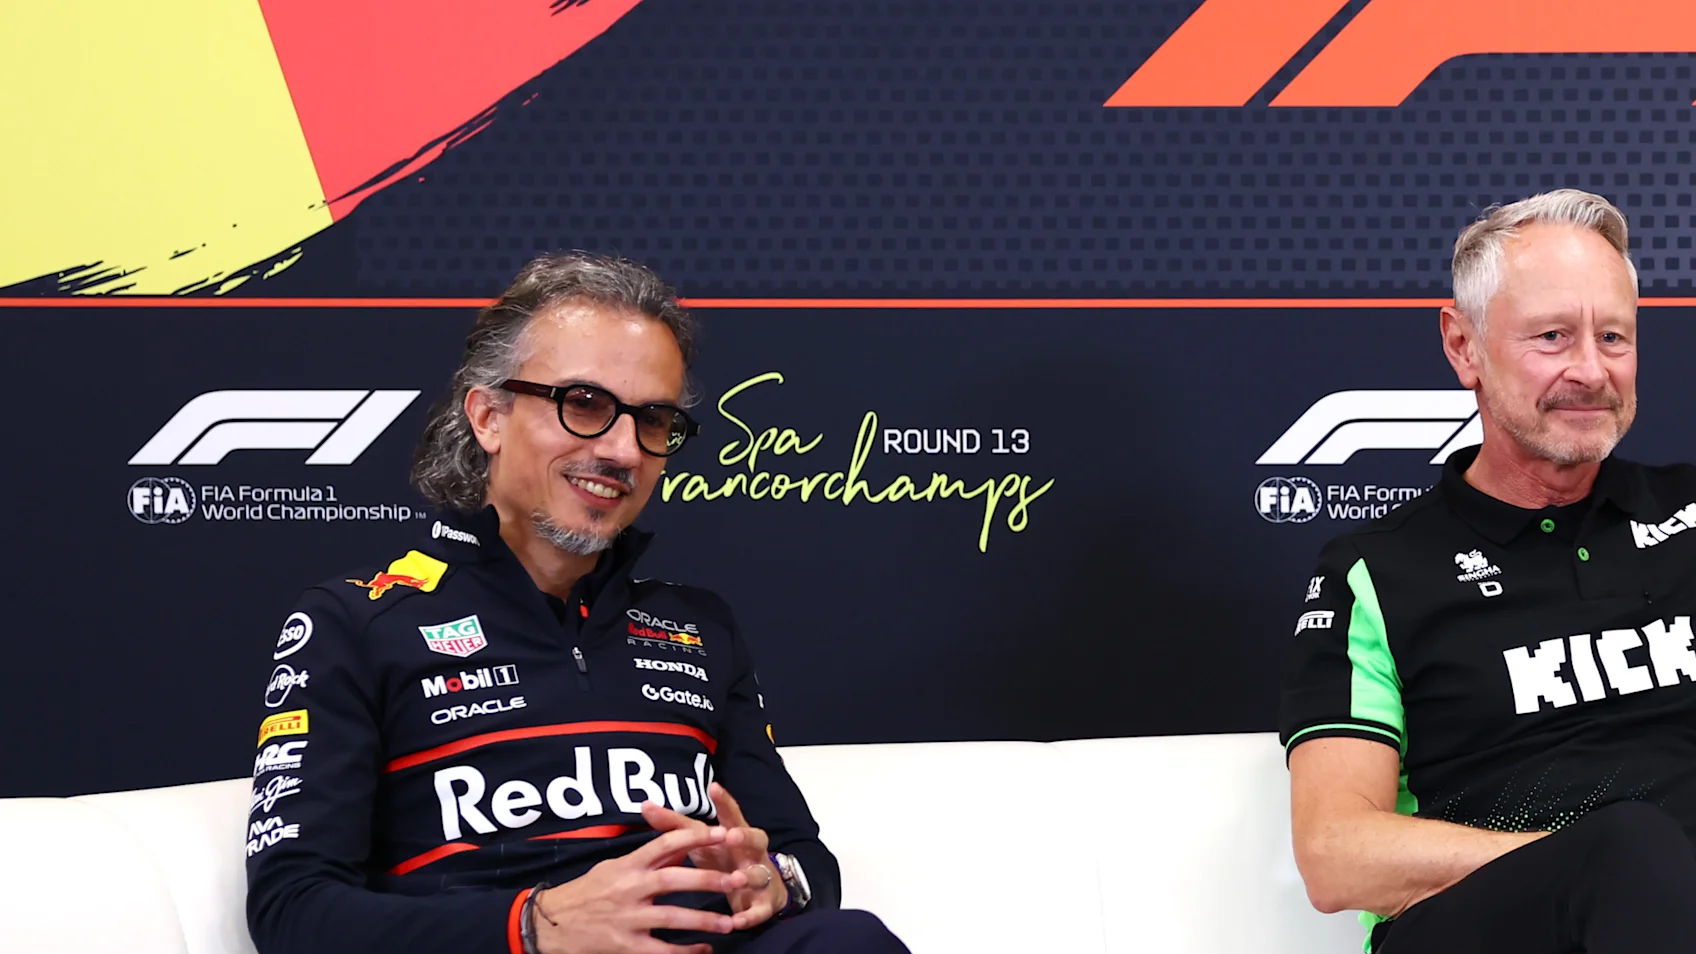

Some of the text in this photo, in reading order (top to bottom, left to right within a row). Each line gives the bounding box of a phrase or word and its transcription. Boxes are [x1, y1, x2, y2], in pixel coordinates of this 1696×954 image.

[127, 389, 422, 465] F1
[718, 371, 824, 474] Spa
[1255, 389, 1485, 465] F
[883, 428, 1031, 454] ROUND 13
[201, 485, 338, 502] FIA Formula 1
[660, 410, 1055, 553] rancorchamps
[1327, 485, 1434, 501] FIA Form
[201, 503, 263, 521] World
[267, 503, 412, 523] Championship
[1327, 503, 1388, 520] World
[425, 620, 478, 640] TAG
[626, 608, 700, 634] ORACLE
[430, 635, 484, 655] HEUER
[627, 637, 708, 657] RACING
[421, 668, 493, 698] Mobil
[633, 658, 709, 682] HONDA
[430, 696, 527, 725] ORACLE
[659, 686, 714, 711] Gate.io
[265, 762, 302, 772] RACING
[434, 746, 719, 841] Red Bull
[246, 823, 300, 858] RADE
[249, 815, 284, 841] AVA
